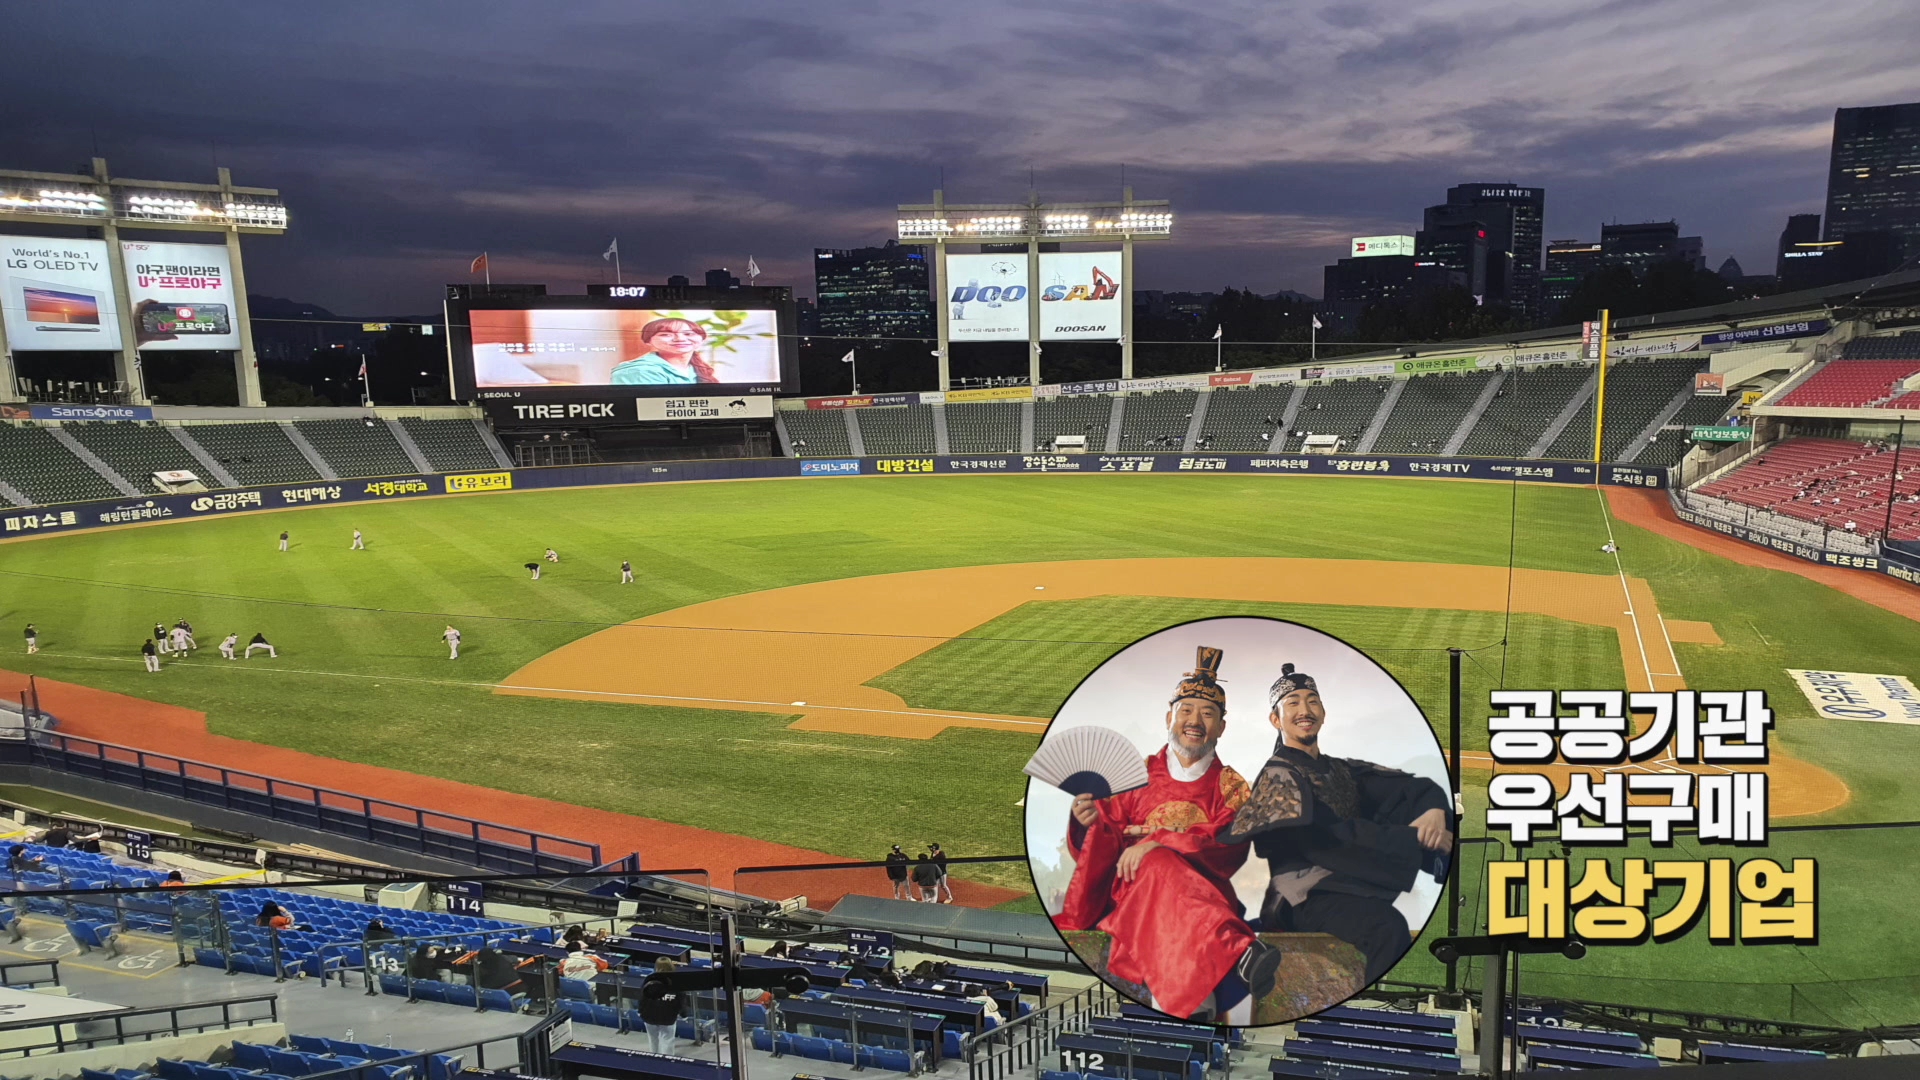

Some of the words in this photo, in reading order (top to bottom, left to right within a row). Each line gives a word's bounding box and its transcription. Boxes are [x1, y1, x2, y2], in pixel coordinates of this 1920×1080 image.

[12, 248, 61, 259] World's
[63, 250, 90, 260] No.1
[7, 258, 28, 270] LG
[34, 259, 76, 271] OLED
[78, 261, 99, 272] TV
[136, 264, 221, 277] 야구팬이라면
[609, 286, 646, 297] 18:07
[1054, 325, 1107, 333] DOOSAN
[1762, 321, 1809, 336] 신협보험
[1061, 382, 1118, 395] 선수촌병원
[665, 400, 686, 408] 쉽고
[689, 399, 709, 408] 편한
[51, 407, 134, 419] Samsonite
[513, 403, 564, 420] TIRE
[569, 402, 615, 418] PICK
[666, 409, 696, 418] 타이어
[700, 408, 719, 417] 교체
[811, 462, 859, 472] 도미노피자
[877, 458, 934, 473] 대방건설
[950, 460, 1007, 469] 한국경제신문
[1179, 458, 1227, 470] 집코노미
[1250, 459, 1309, 469] 페퍼저축은행
[1573, 466, 1591, 474] 100m
[465, 474, 508, 489] 유보라
[1611, 473, 1644, 485] 주식창
[282, 485, 342, 503] 현대해상
[364, 481, 429, 496] 서경대학교
[213, 491, 262, 510] 금강주택
[4, 511, 77, 532] 피자스쿨
[99, 507, 173, 523] 해링턴플레이스
[1825, 553, 1878, 569] 백조씽크
[1887, 565, 1912, 582] meritz
[127, 841, 150, 859] 115
[447, 896, 481, 912] 114
[369, 954, 399, 972] 113
[1061, 1050, 1105, 1071] 112
